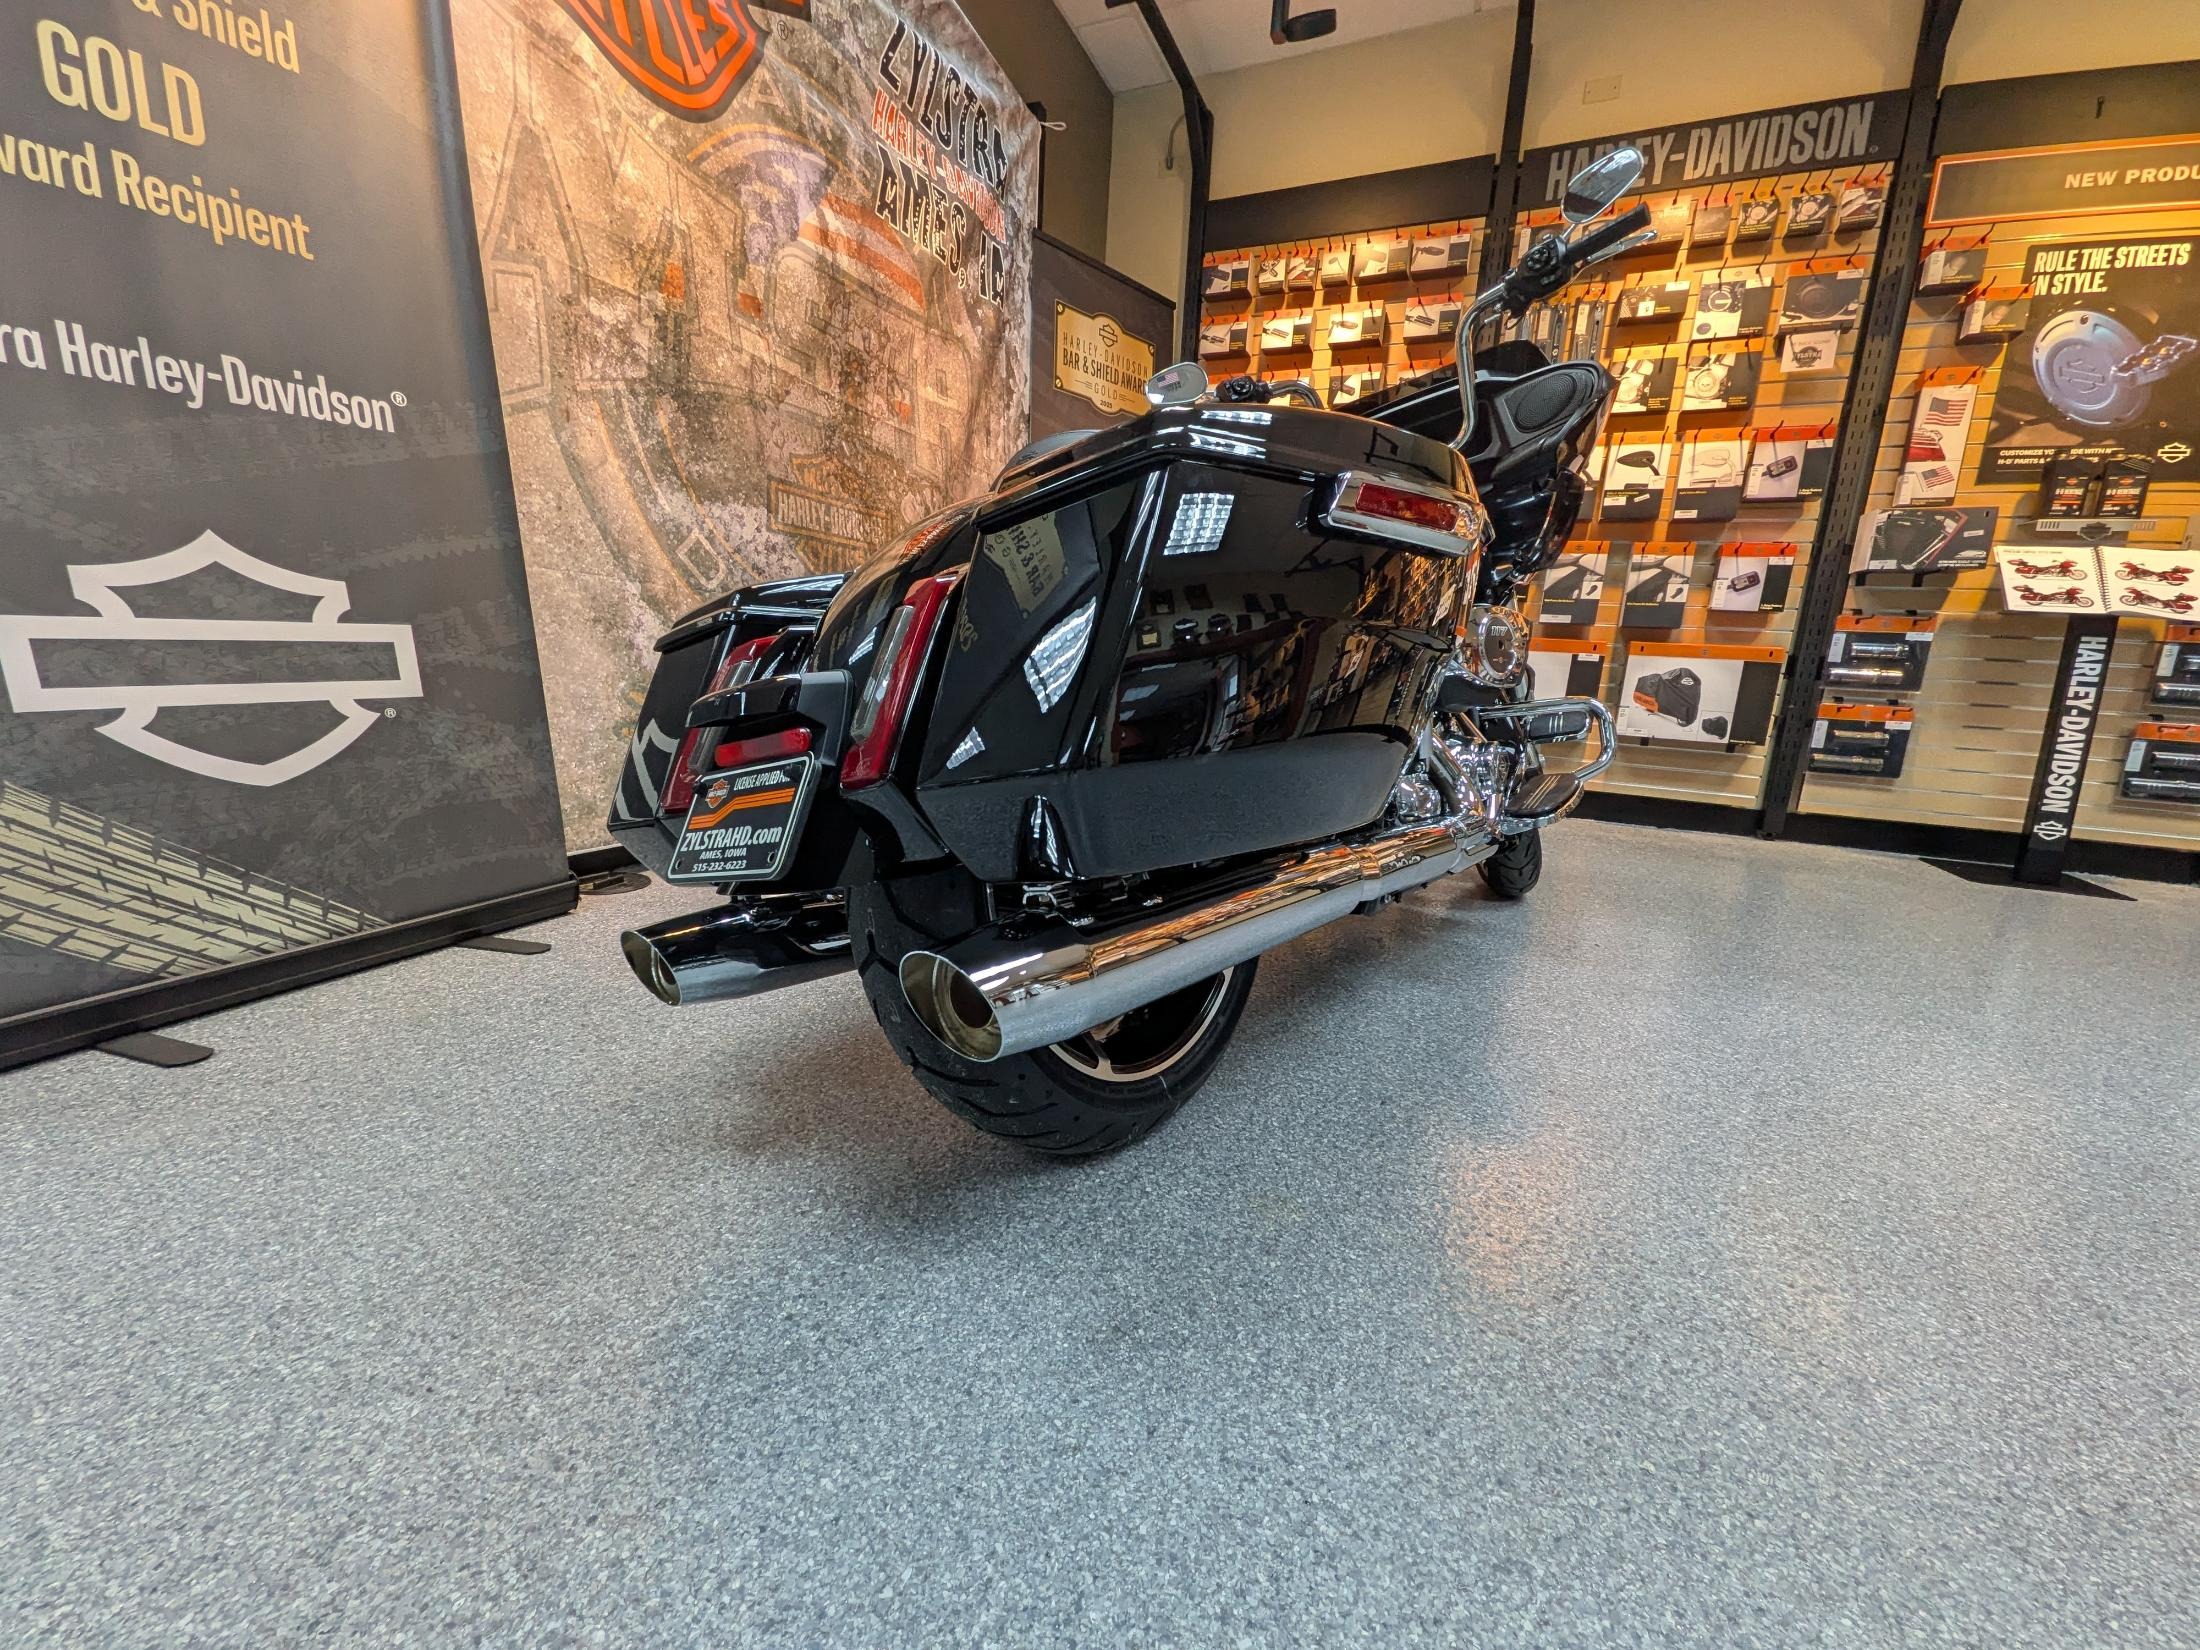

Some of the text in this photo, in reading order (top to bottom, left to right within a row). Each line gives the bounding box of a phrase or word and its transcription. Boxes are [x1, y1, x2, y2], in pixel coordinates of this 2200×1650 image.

[36, 19, 206, 147] GOLD
[1545, 101, 1875, 201] HAEY-DAVIDSON
[2064, 170, 2118, 189] NEW
[111, 149, 314, 260] Recipient
[2033, 242, 2192, 273] RULE THE STREETS
[2051, 271, 2109, 295] STYLE.
[1063, 332, 1148, 378] HARLEY-DAVIDSON
[1063, 348, 1080, 371] BAR
[1083, 356, 1089, 374] &
[1091, 359, 1119, 385] SHIELD
[1094, 383, 1118, 400] GOLD
[1100, 400, 1112, 408] 2025
[2014, 457, 2039, 465] PARTS
[1491, 626, 1508, 637] 117
[2041, 636, 2109, 814] HARLEY-DAVIDSON
[733, 774, 757, 790] LICENSE
[755, 770, 780, 786] APPLIED
[680, 825, 783, 852] ZYLSTRAHD.com
[692, 860, 747, 872] 515-232-6223
[700, 848, 747, 861] AMES, IOWA
